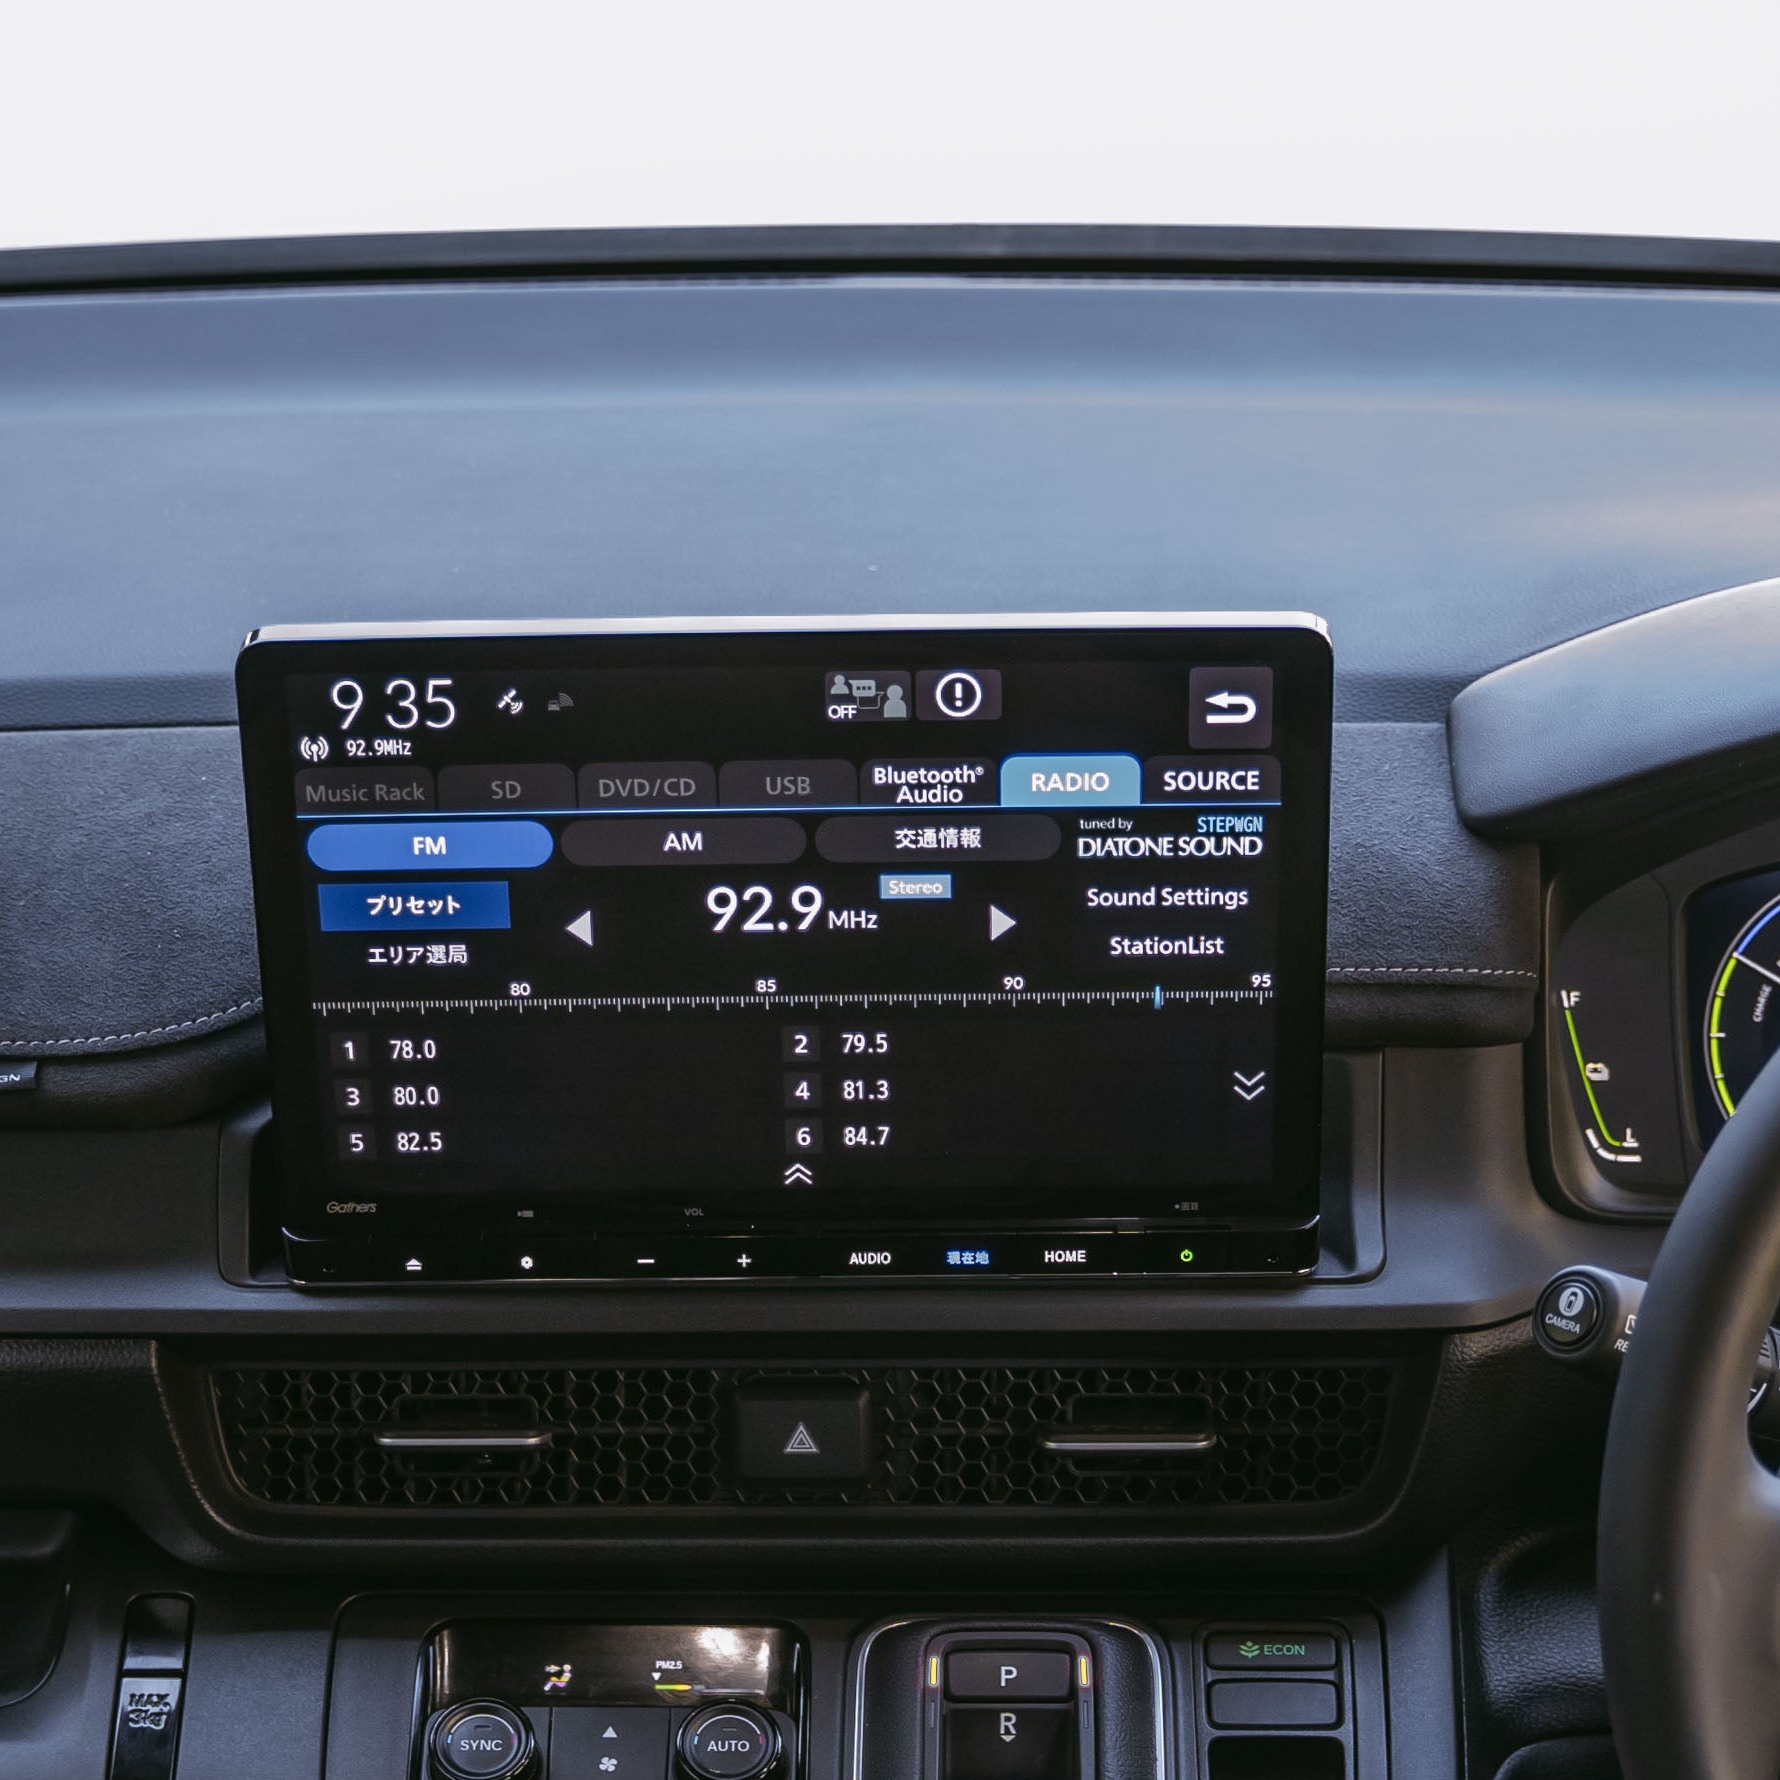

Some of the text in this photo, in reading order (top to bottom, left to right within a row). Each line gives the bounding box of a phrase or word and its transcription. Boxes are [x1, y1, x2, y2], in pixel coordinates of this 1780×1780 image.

[330, 677, 456, 730] 9 35
[827, 704, 858, 720] OFF
[345, 738, 412, 757] 92.9MHz
[491, 780, 522, 800] SD
[598, 777, 696, 798] DVD/CD
[765, 776, 811, 796] USB
[1031, 772, 1110, 792] RADIO
[1163, 770, 1260, 792] SOURCE
[305, 781, 426, 803] Music Rack
[896, 785, 964, 804] Audio
[1079, 817, 1134, 832] tuned by
[1197, 815, 1264, 833] STEPWGN
[413, 835, 447, 856] FM
[663, 831, 703, 852] AM
[894, 826, 982, 849] 交通情報
[1077, 835, 1264, 858] DIATONE SOUND
[889, 880, 943, 895] Stereo
[366, 894, 461, 916] プリセット
[706, 884, 878, 933] 92.9 MHz
[1087, 886, 1249, 911] Sound Settings
[368, 944, 468, 965] エリア選局
[1110, 935, 1225, 955] StationList
[510, 973, 1272, 997] 80 85 90 95
[1570, 991, 1580, 1007] F
[344, 1039, 437, 1060] 1 78.0
[794, 1033, 888, 1054] 2 79.5
[346, 1086, 440, 1107] 3 80.0
[794, 1079, 889, 1101] 4 81.3
[349, 1131, 443, 1153] 5 82.5
[796, 1125, 890, 1146] 6 84.7
[326, 1201, 378, 1214] Gathers
[684, 1207, 705, 1217] VOL
[849, 1251, 892, 1265] AUDIO
[946, 1250, 990, 1265] 現在地
[1044, 1249, 1087, 1263] HOME
[1545, 1313, 1580, 1334] CAMERA
[1263, 1644, 1306, 1656] ECON
[655, 1660, 683, 1670] PM2.5
[1000, 1666, 1018, 1687] P
[999, 1713, 1017, 1734] R
[460, 1739, 503, 1751] SYNC
[706, 1740, 750, 1752] AUTO
